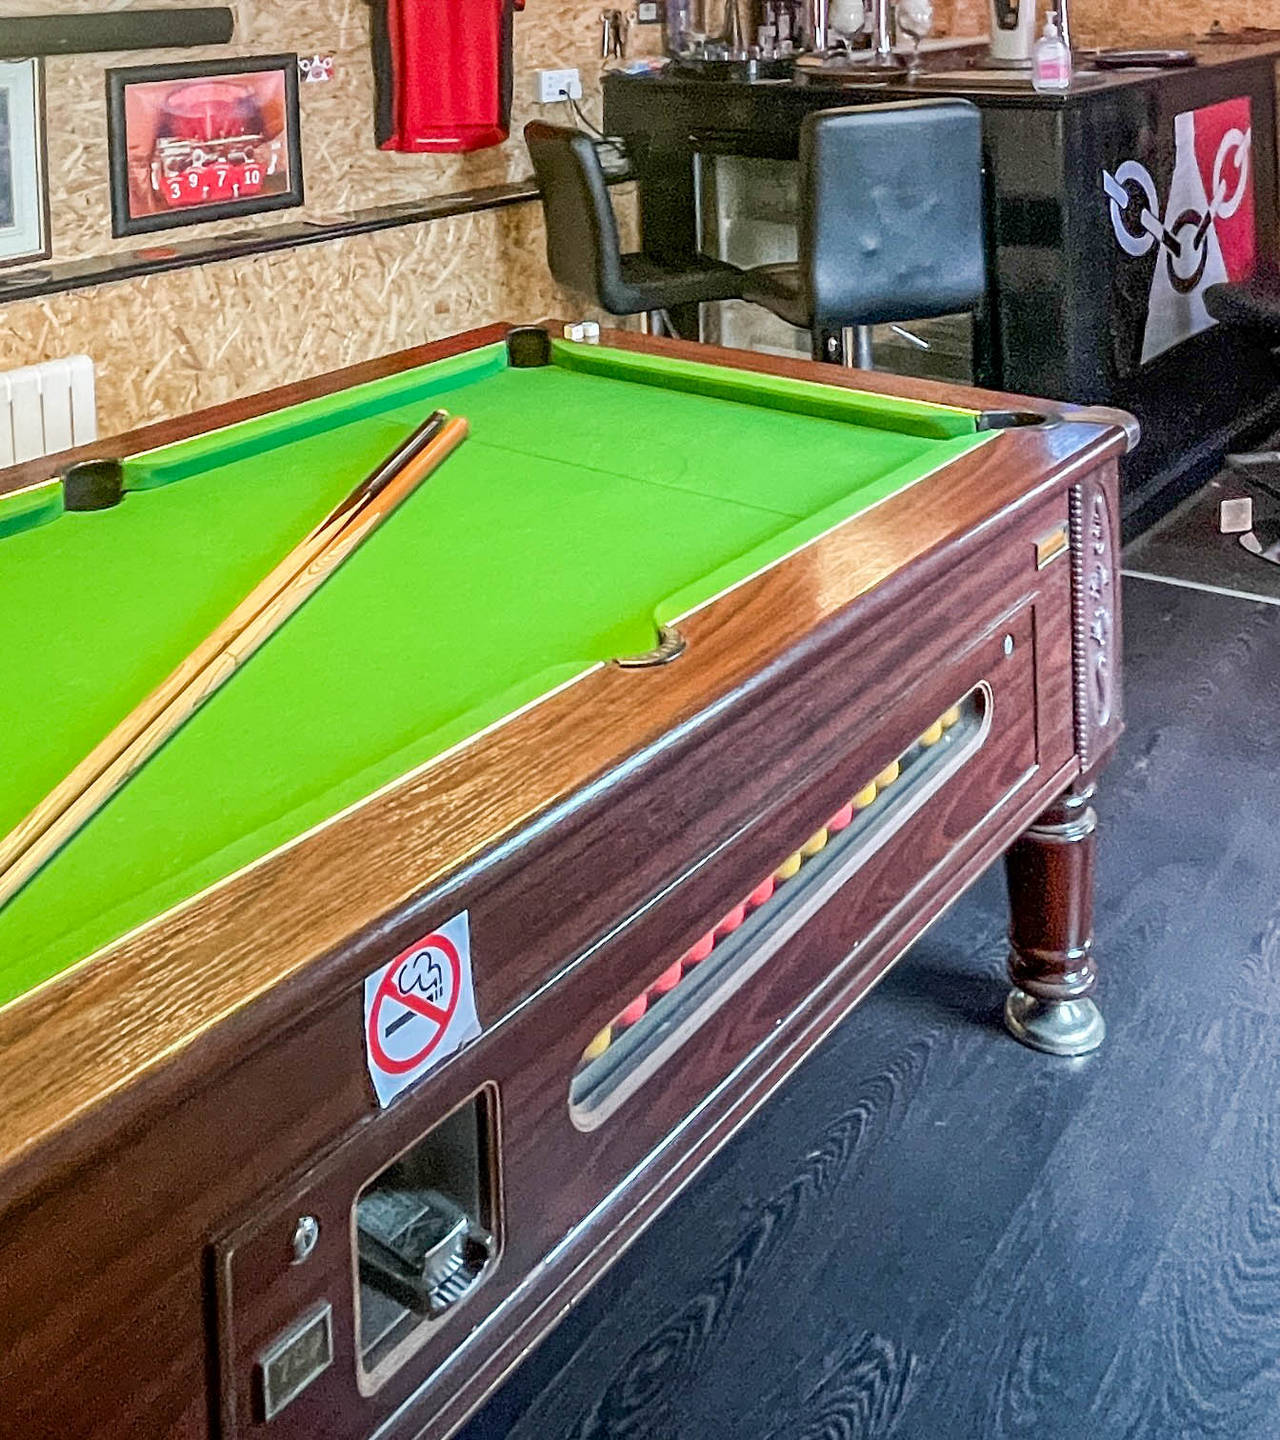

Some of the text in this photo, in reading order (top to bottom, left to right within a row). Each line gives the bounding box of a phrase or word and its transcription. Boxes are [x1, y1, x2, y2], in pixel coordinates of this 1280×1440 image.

[188, 173, 199, 188] 9
[217, 170, 227, 188] 7
[244, 170, 260, 184] 10
[171, 182, 181, 199] 3
